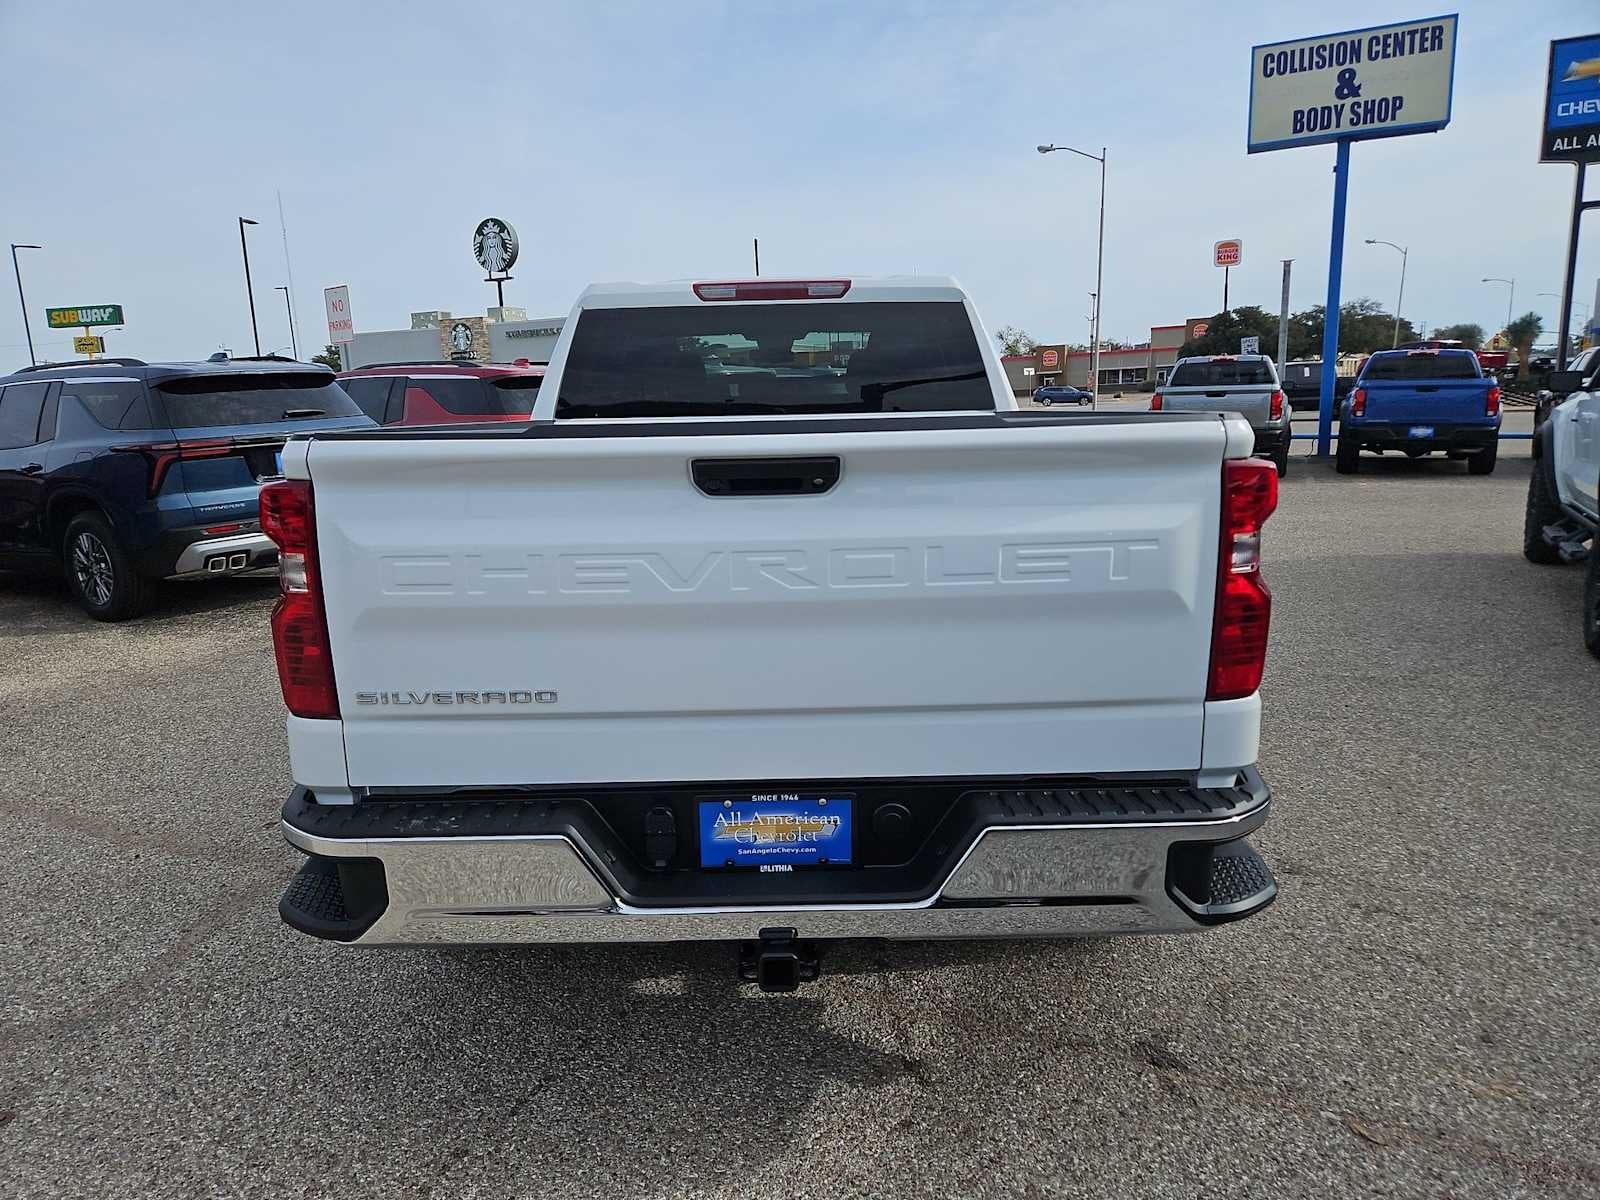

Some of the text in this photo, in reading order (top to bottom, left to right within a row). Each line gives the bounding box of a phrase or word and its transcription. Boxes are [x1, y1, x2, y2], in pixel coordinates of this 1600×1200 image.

[1262, 25, 1444, 78] COLLISION CENTER
[1334, 67, 1362, 101] &
[1292, 96, 1403, 134] BODY SHOP
[1552, 136, 1582, 151] ALL
[1217, 247, 1239, 255] BURGER
[331, 299, 344, 312] NO
[50, 308, 113, 324] SUBWAY
[329, 319, 352, 331] PARKING
[378, 539, 1160, 597] CHEVROLET
[356, 690, 559, 706] SILVERADO
[713, 810, 841, 828] All American
[734, 827, 818, 844] Chevrolet
[737, 847, 817, 855] SanAngeloChevy.com
